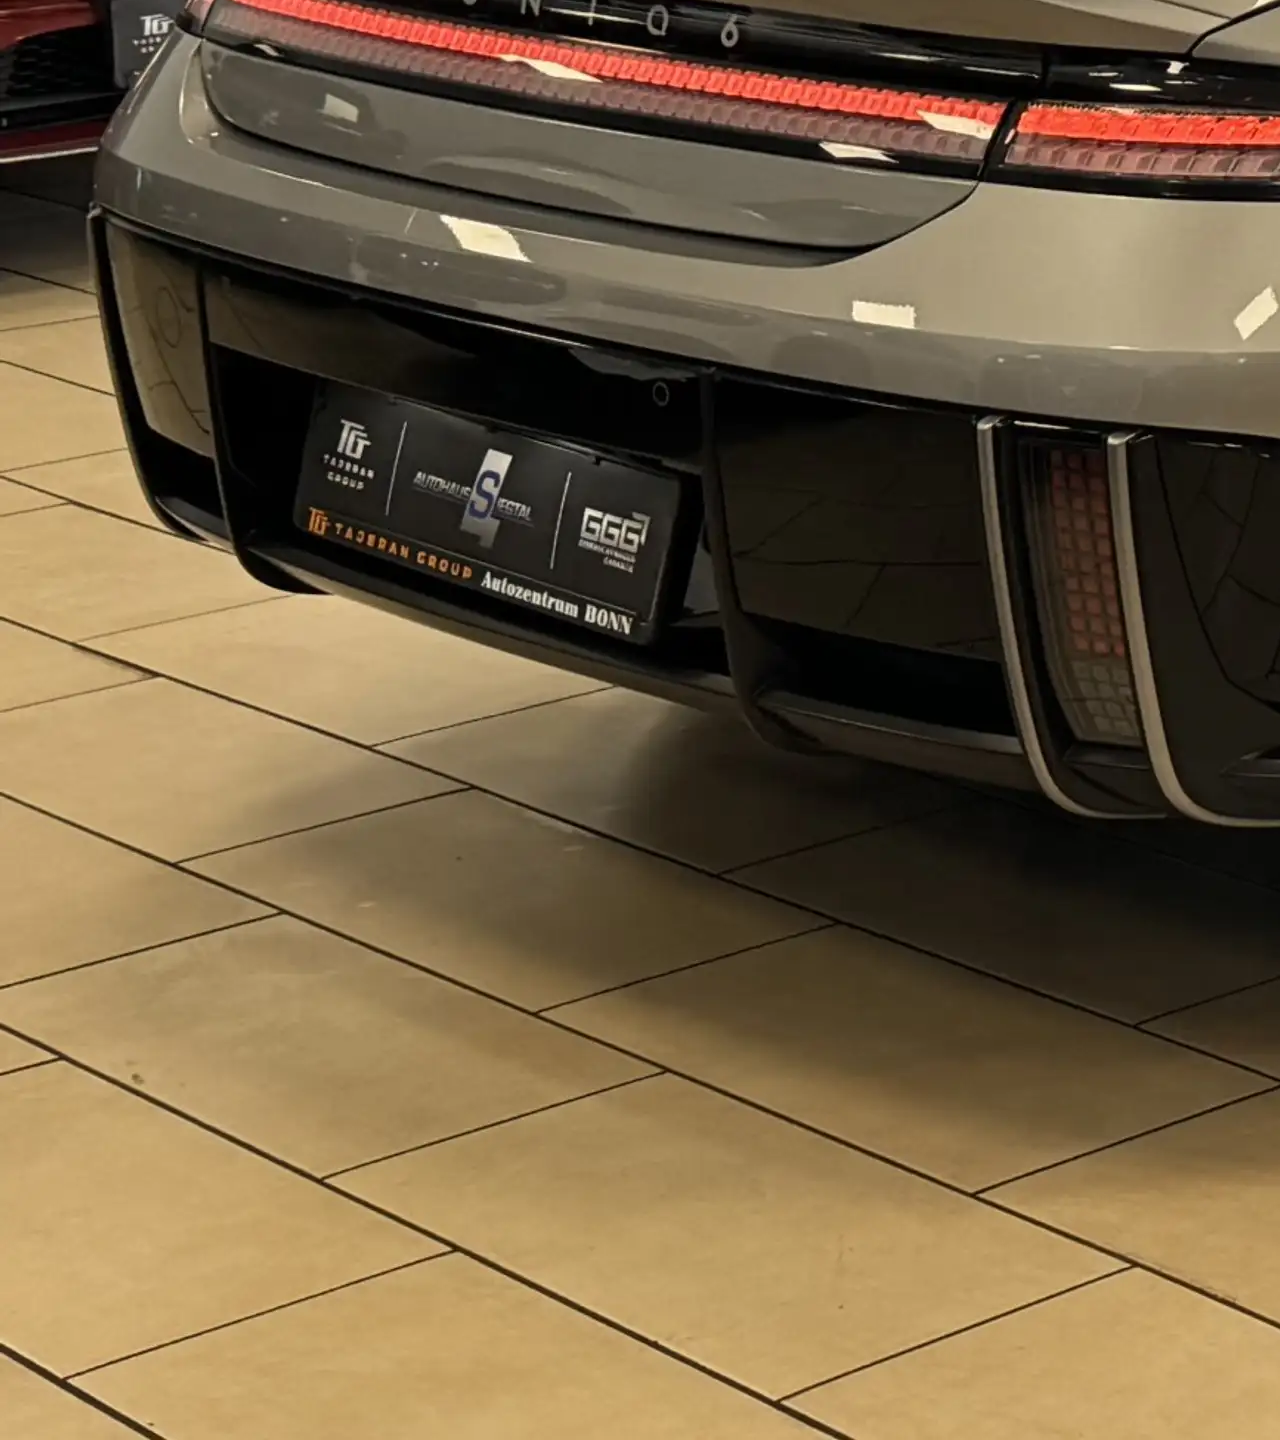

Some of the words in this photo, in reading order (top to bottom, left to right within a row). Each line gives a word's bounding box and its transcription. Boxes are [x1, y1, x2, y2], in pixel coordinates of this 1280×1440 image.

[720, 14, 740, 48] 6
[413, 471, 472, 498] AUTOHAUS
[480, 570, 579, 619] Autozentrum
[584, 603, 633, 636] BONN
